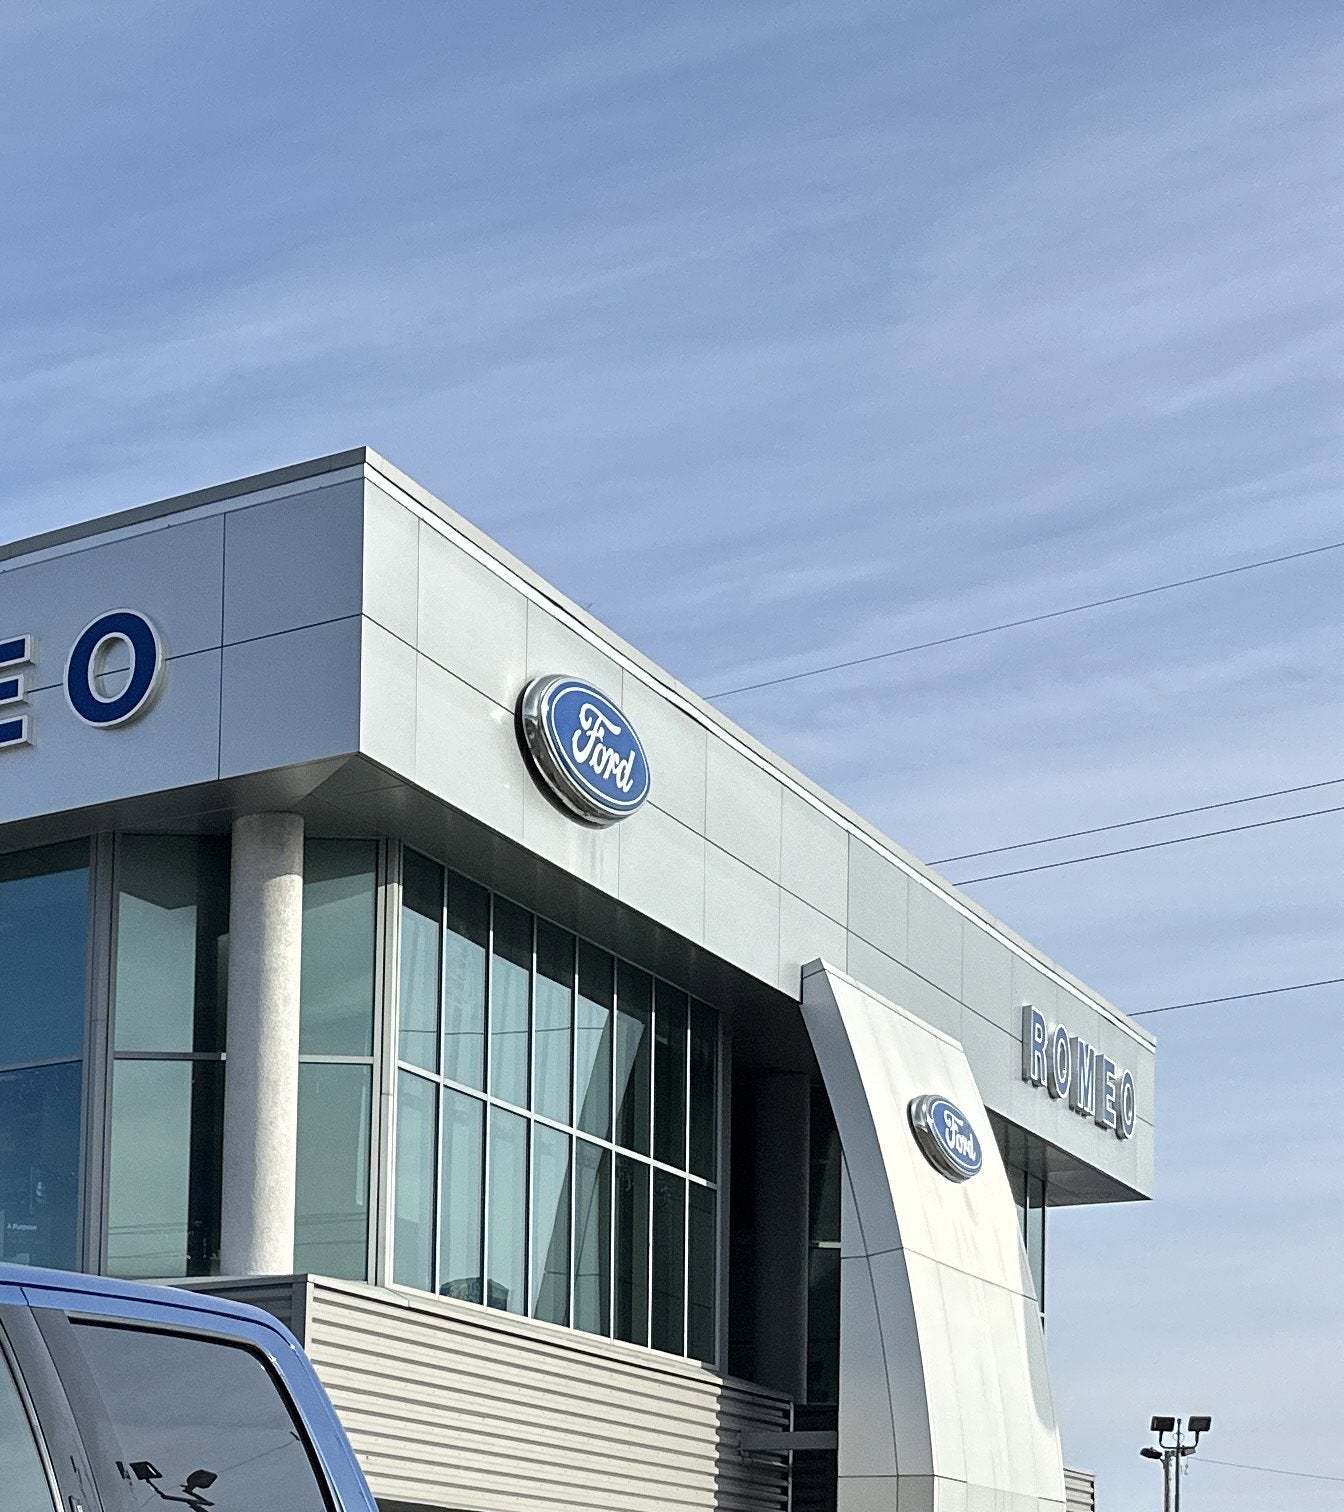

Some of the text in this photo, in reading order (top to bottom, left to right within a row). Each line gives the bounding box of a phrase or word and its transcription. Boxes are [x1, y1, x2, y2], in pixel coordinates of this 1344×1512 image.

[572, 703, 635, 792] Ford
[1023, 1005, 1137, 1140] ROMEO
[944, 1109, 976, 1161] Ford
